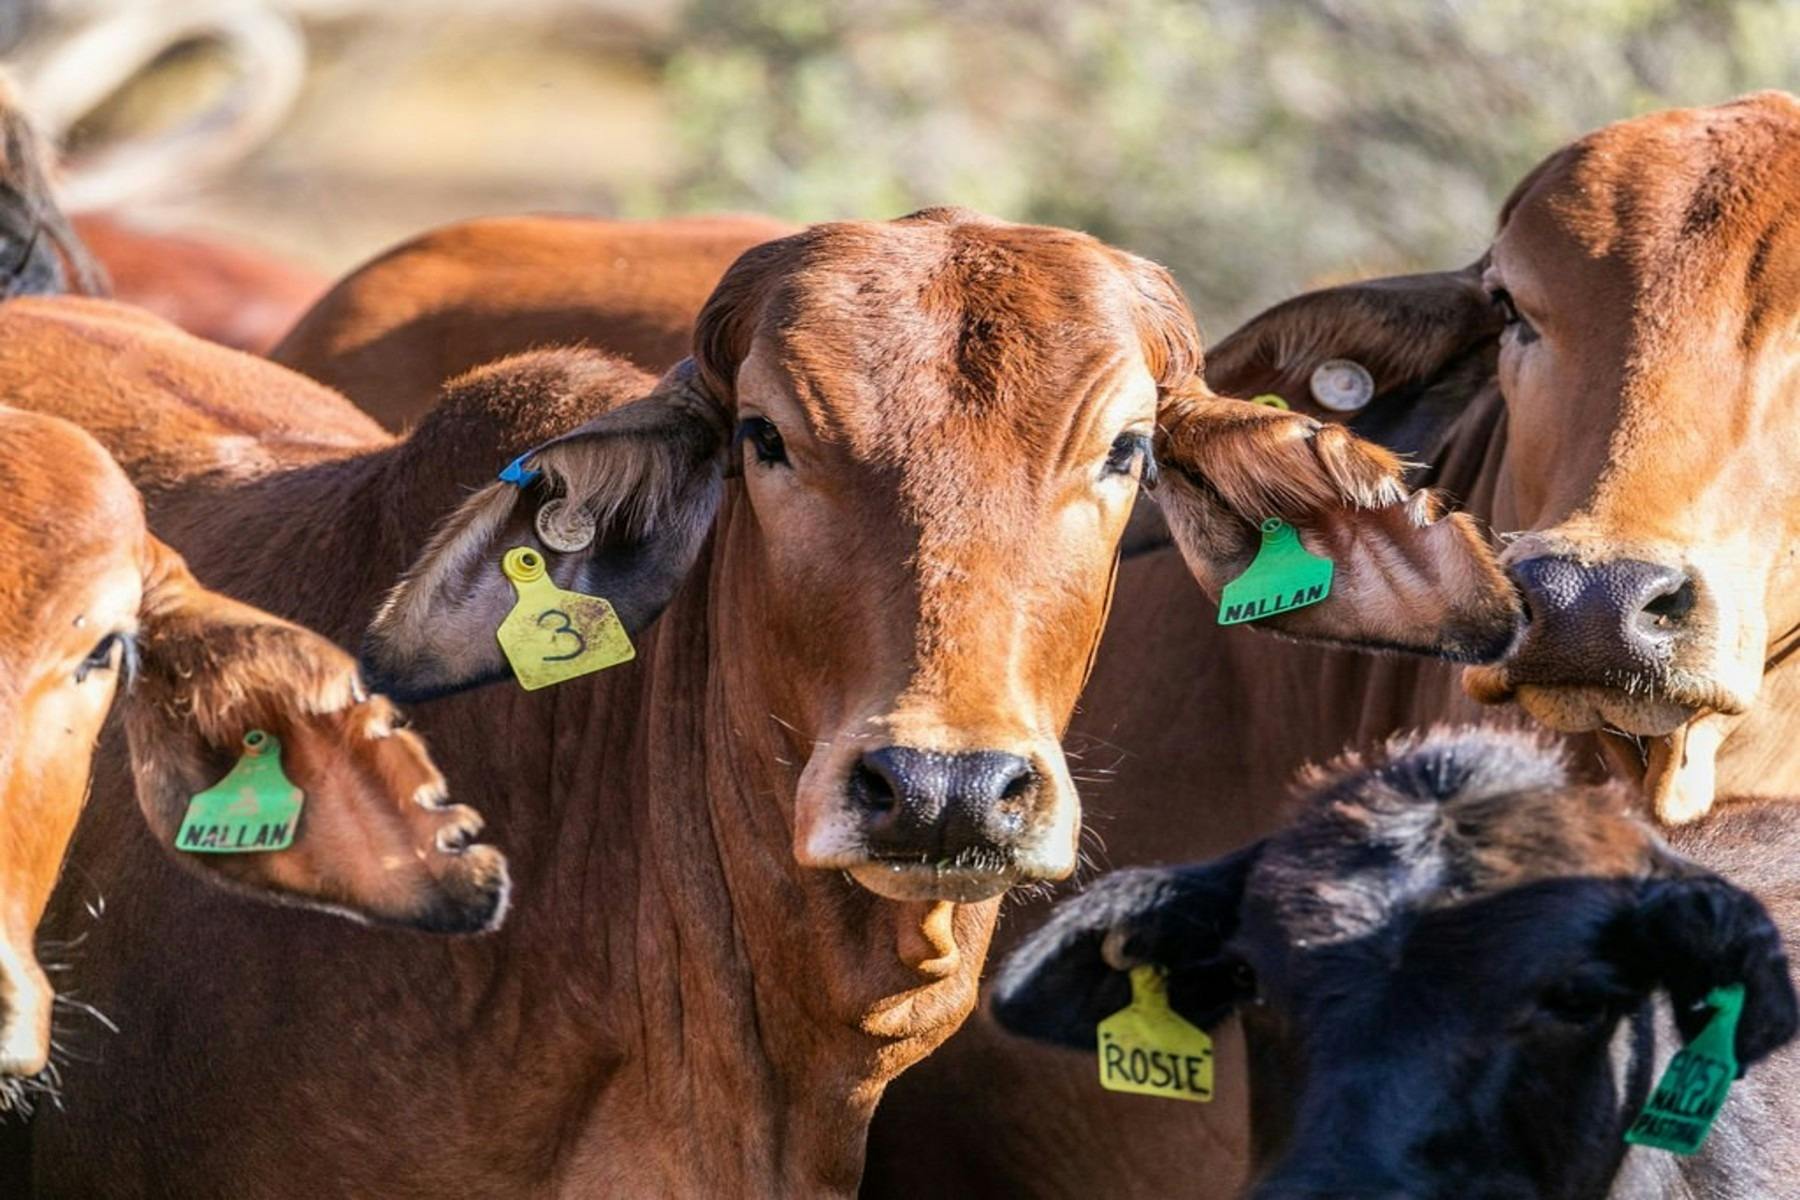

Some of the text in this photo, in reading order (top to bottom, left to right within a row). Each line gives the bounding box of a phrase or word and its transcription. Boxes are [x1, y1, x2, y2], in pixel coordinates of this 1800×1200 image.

[1224, 584, 1324, 621] NALLAN
[537, 609, 588, 661] 3
[182, 823, 290, 848] NALLAN
